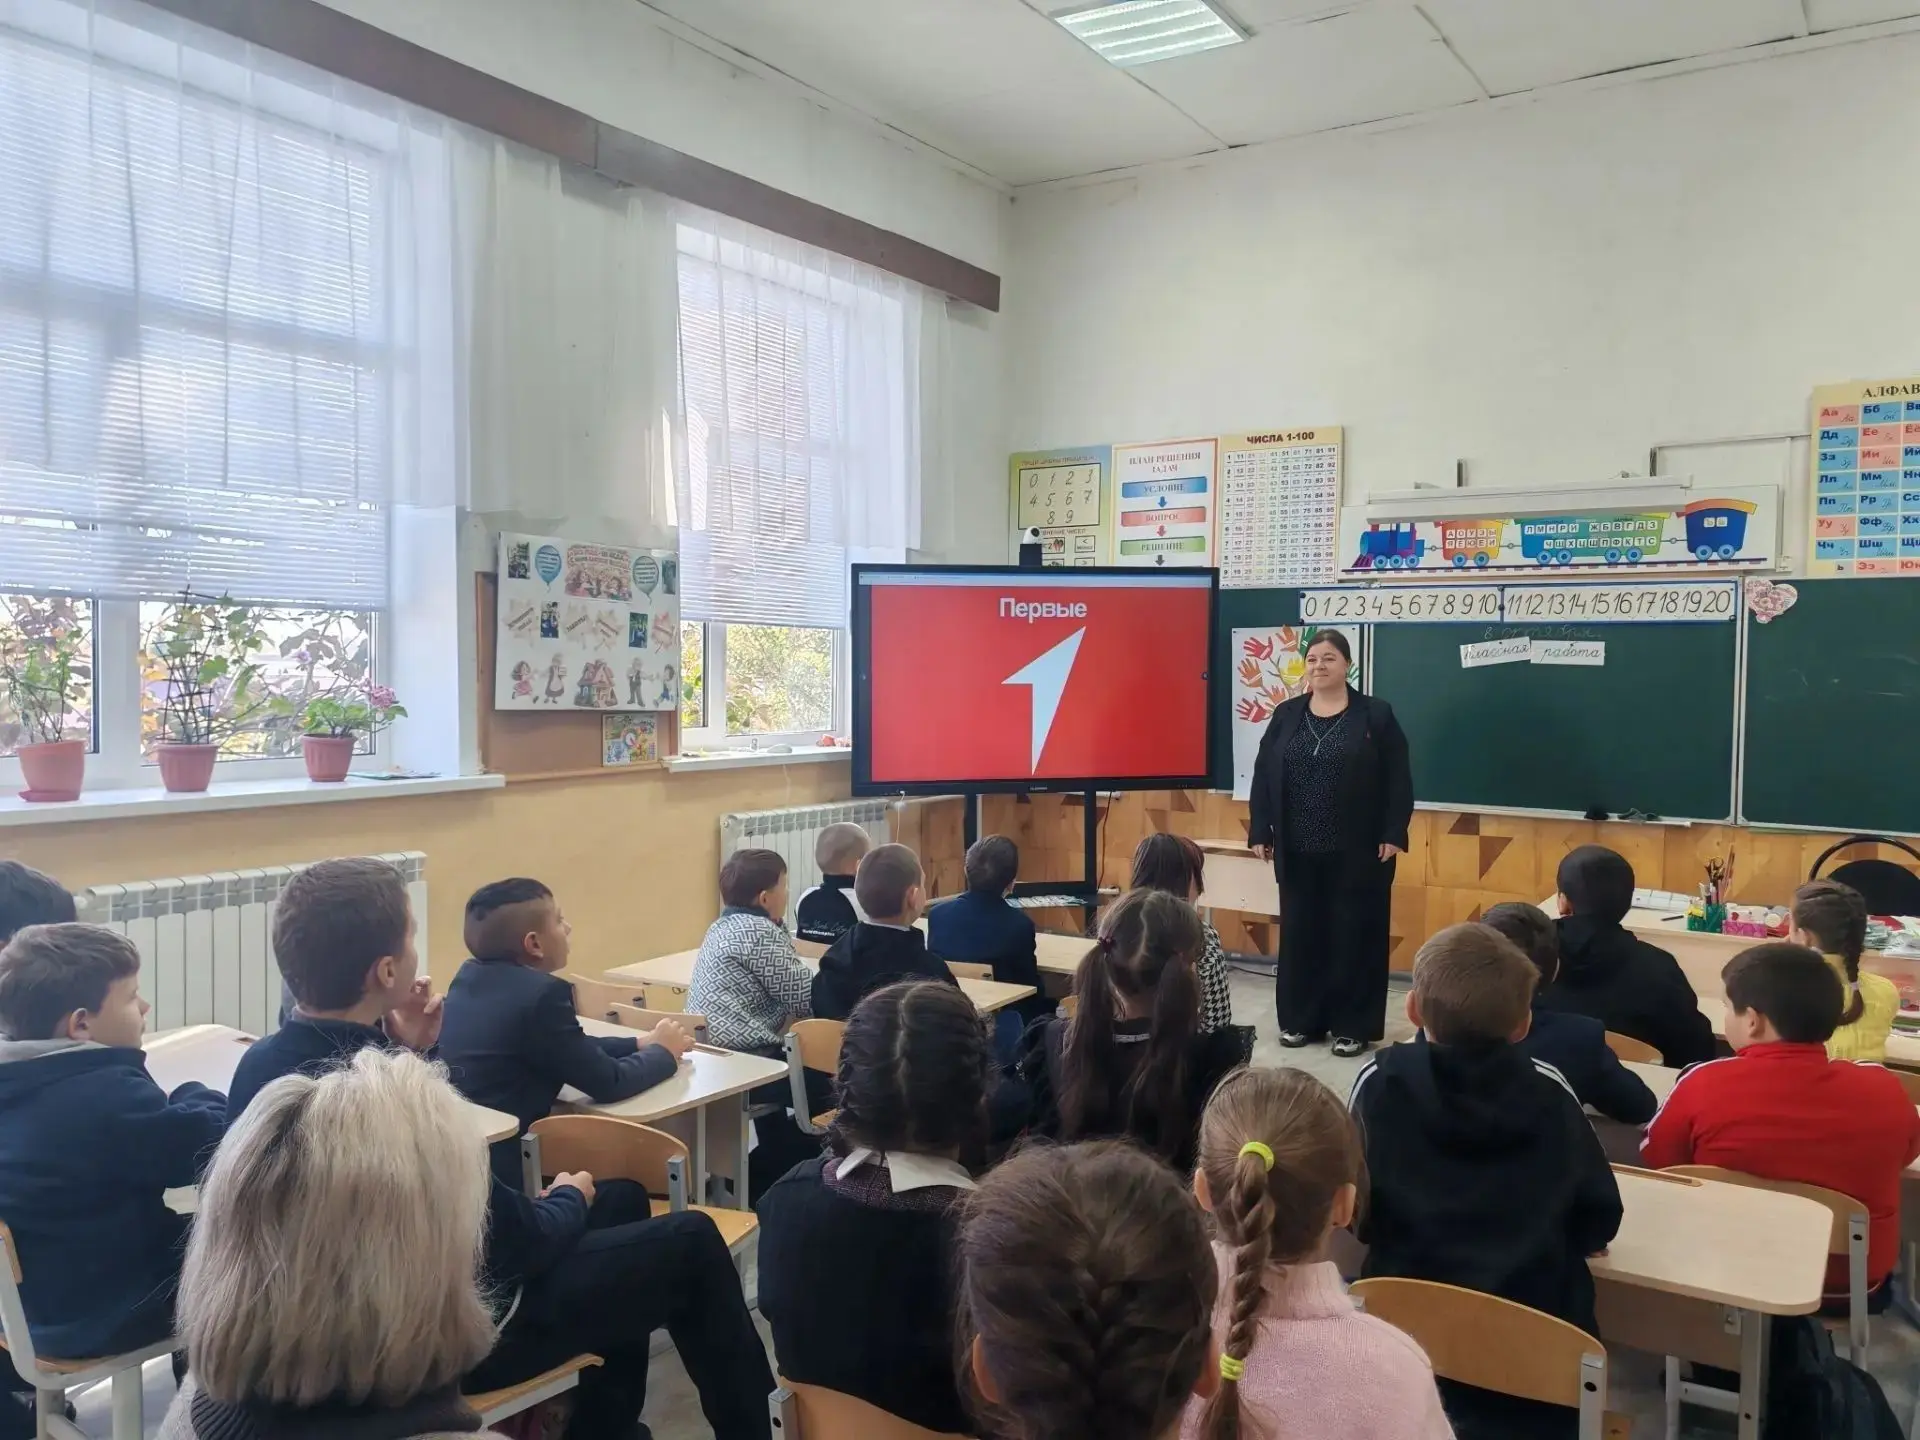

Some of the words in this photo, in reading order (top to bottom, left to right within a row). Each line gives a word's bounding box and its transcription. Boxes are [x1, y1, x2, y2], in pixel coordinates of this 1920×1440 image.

[1862, 384, 1920, 397] АЛФАВ
[1864, 405, 1880, 413] Бб
[1247, 434, 1283, 444] ЧИСЛА
[1287, 432, 1314, 440] 1-100
[1156, 452, 1201, 462] РЕШЕНИЯ
[1030, 474, 1038, 488] 0
[1050, 472, 1056, 486] 1
[1066, 471, 1074, 485] 2
[1085, 469, 1094, 484] 3
[1862, 472, 1882, 481] Мм
[1144, 484, 1185, 493] УСЛОВИЕ
[1029, 494, 1037, 508] 4
[1045, 493, 1056, 506] 5
[1065, 491, 1074, 505] 6
[1084, 489, 1092, 504] 7
[1047, 511, 1055, 524] 8
[1065, 510, 1074, 523] 9
[1142, 542, 1185, 552] РЕШЕНИЕ
[1305, 597, 1317, 617] 0
[1323, 596, 1331, 616] 1
[1335, 596, 1349, 616] 2
[1354, 596, 1366, 616] 3
[1371, 595, 1382, 616] 4
[1390, 595, 1403, 616] 5
[1409, 595, 1422, 615] 6
[1426, 594, 1439, 615] 7
[1443, 594, 1456, 615] 8
[1460, 594, 1474, 614] 9
[1478, 593, 1497, 614] 10
[1507, 594, 1521, 615] 11
[1525, 593, 1544, 615] 12
[1547, 593, 1565, 614] 13
[1569, 593, 1587, 614] 14
[1591, 592, 1610, 614] 15
[1614, 592, 1632, 614] 16
[1636, 592, 1657, 614] 17
[1660, 591, 1679, 613] 18
[1682, 590, 1702, 613] 19
[1702, 590, 1731, 613] 20
[1000, 598, 1087, 623] Первые
[1540, 644, 1601, 663] работа
